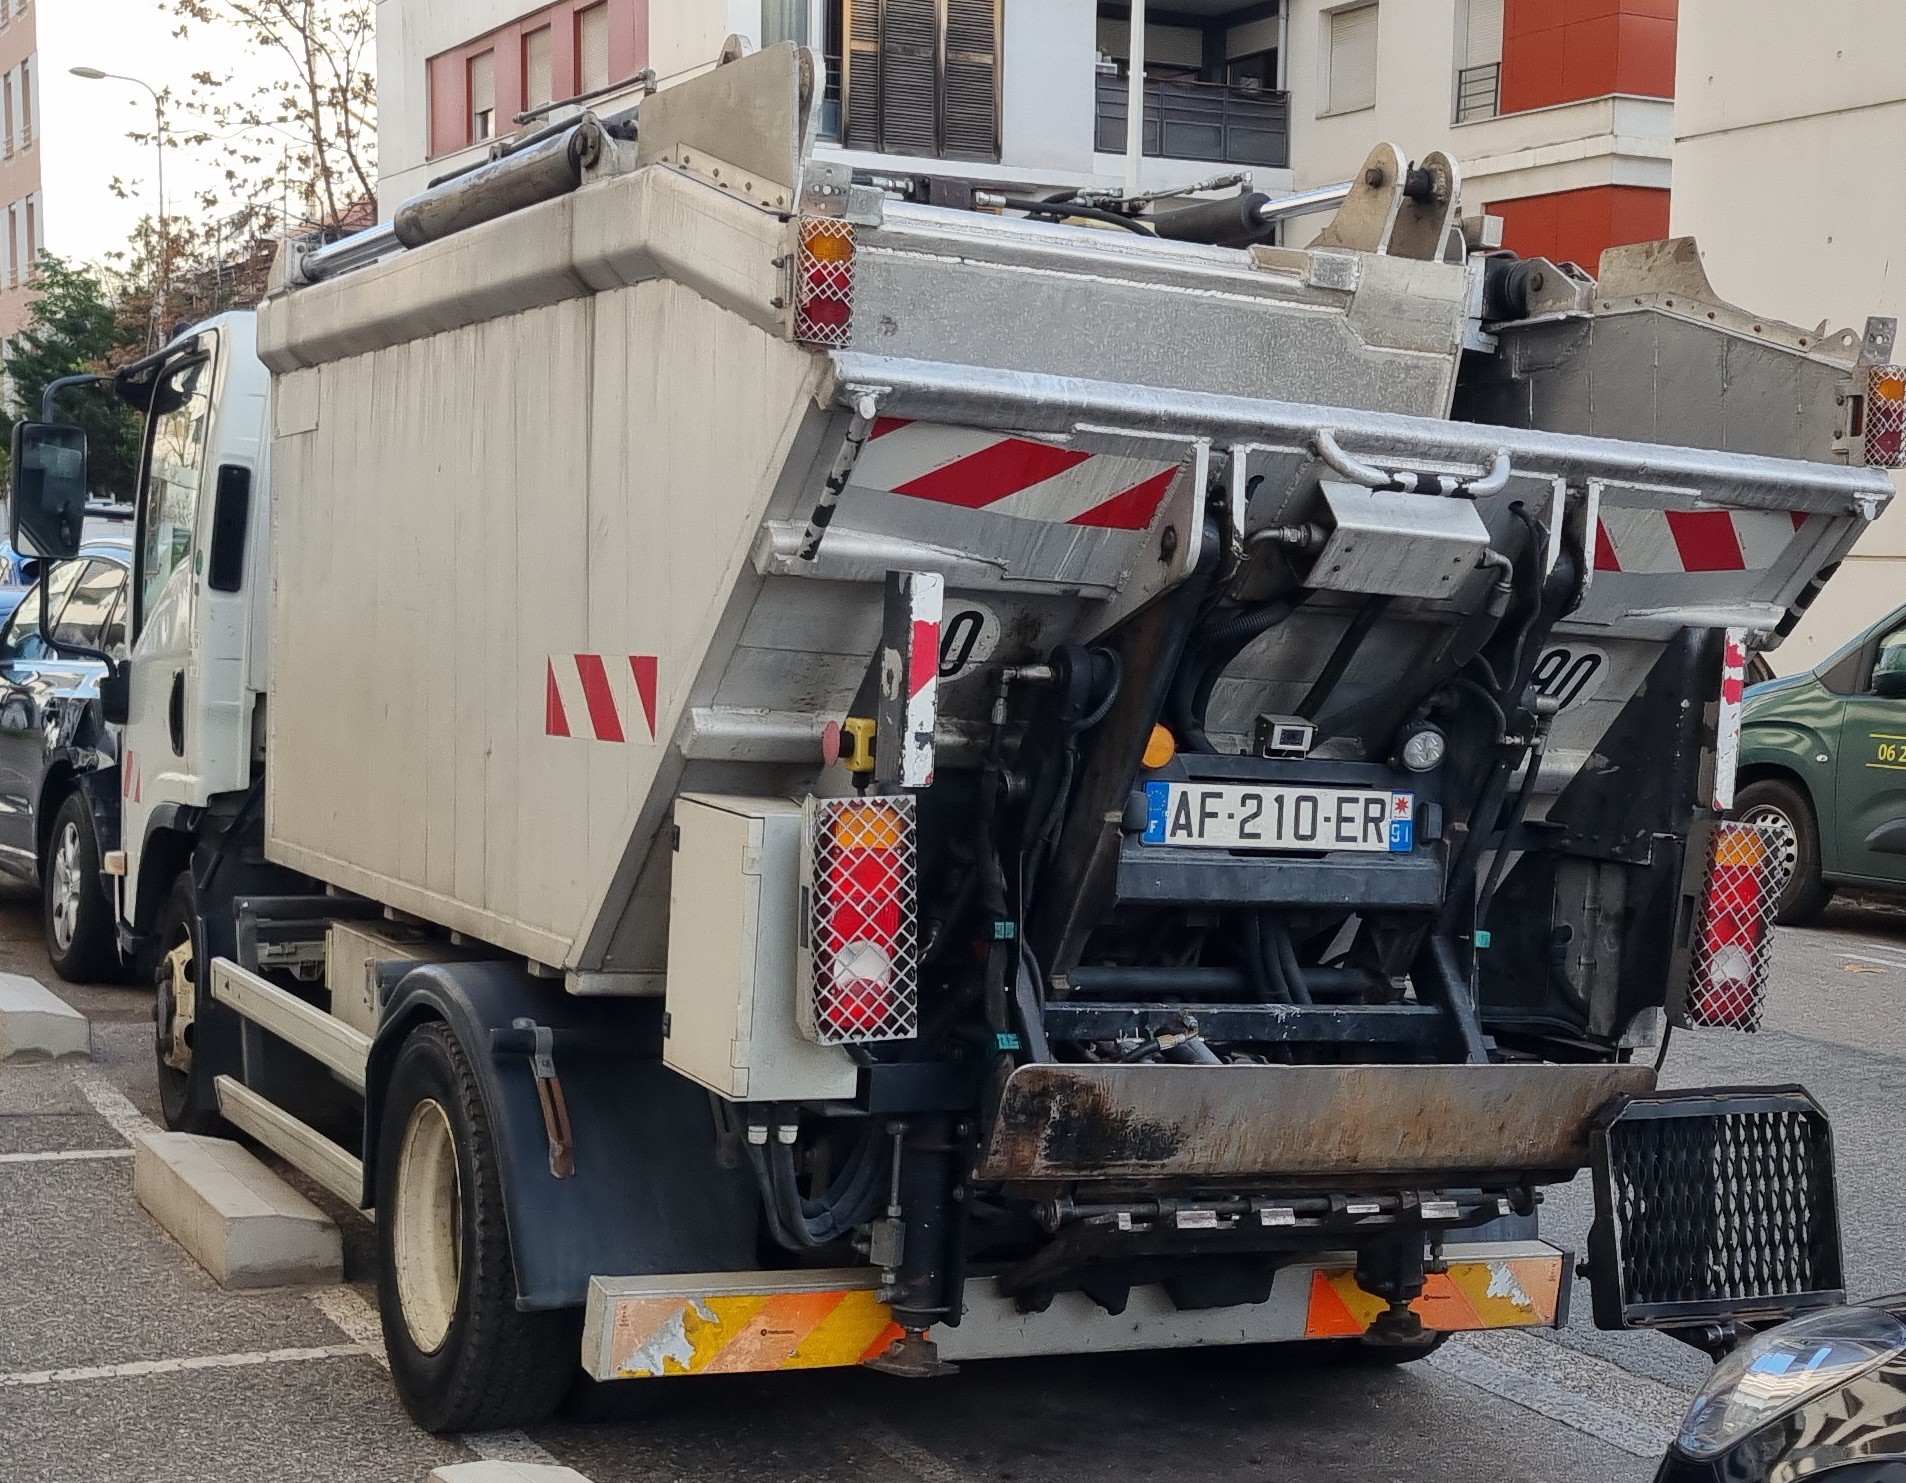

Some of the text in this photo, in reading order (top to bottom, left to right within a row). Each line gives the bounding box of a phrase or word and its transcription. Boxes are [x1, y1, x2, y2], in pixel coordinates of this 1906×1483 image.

[1878, 743, 1896, 762] 06
[1170, 790, 1386, 843] AF-210-ER
[1149, 819, 1159, 834] F
